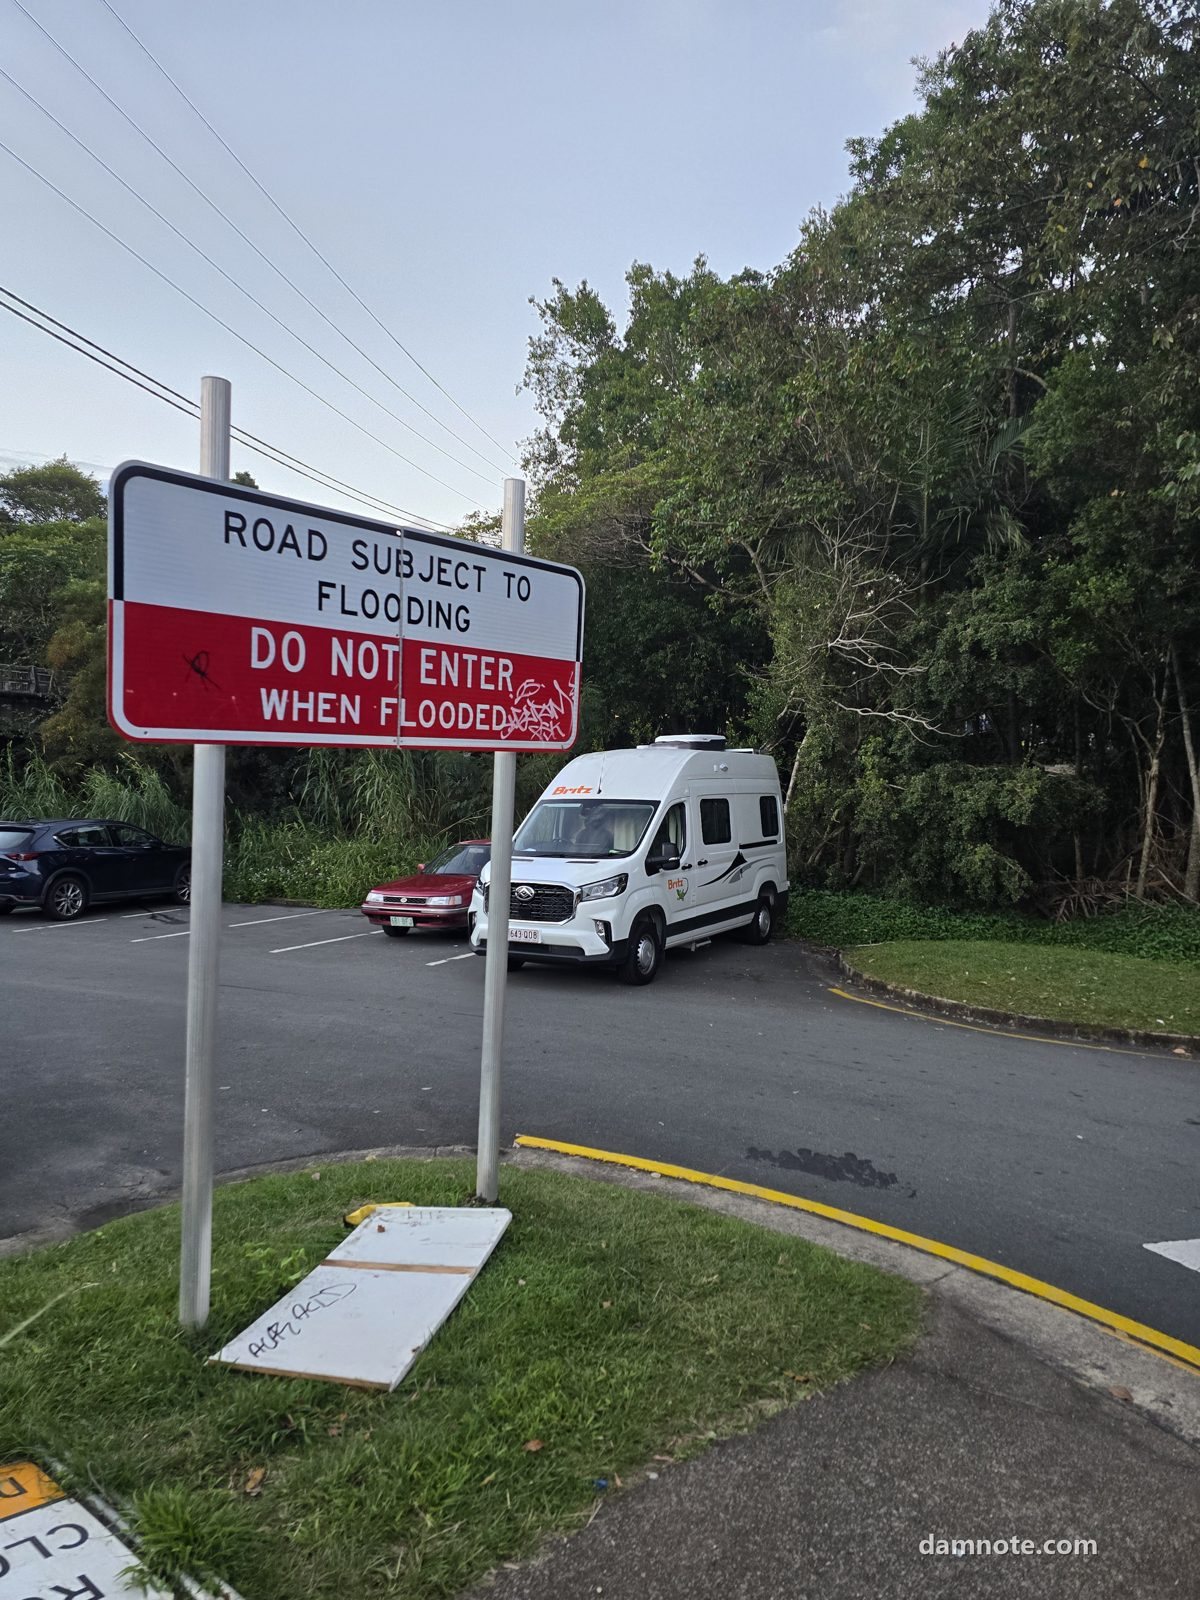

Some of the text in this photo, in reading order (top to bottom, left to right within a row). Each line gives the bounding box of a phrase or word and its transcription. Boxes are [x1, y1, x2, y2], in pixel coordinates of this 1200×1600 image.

[224, 510, 531, 602] ROAD SUBJECT TO
[318, 580, 470, 632] FLOODING
[251, 626, 513, 691] DO NOT ENTER
[260, 687, 360, 724] WHEN
[380, 697, 506, 731] FLOODED
[552, 785, 592, 796] Britz
[667, 878, 684, 890] Britz
